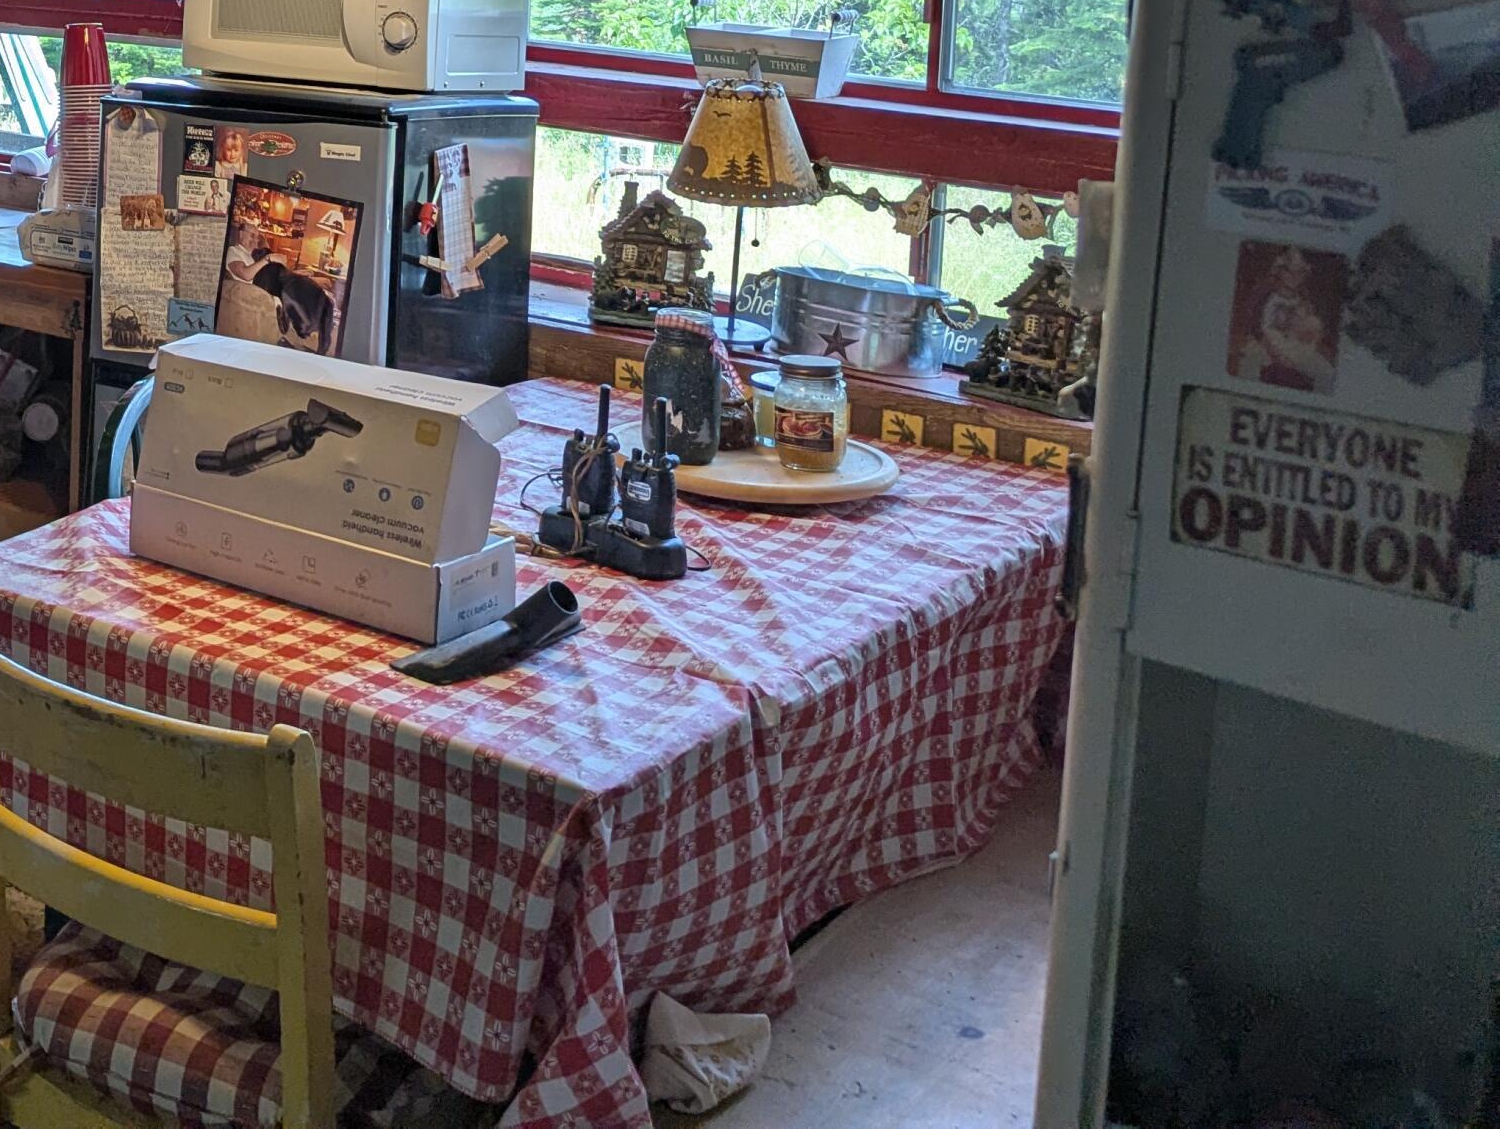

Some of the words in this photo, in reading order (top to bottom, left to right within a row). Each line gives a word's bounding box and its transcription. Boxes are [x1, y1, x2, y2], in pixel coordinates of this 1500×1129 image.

[704, 53, 739, 65] BASIL
[769, 59, 808, 73] THYME
[1229, 405, 1425, 480] EVERYONE
[1188, 444, 1214, 483] IS
[1222, 449, 1357, 512] ENTITLED
[1366, 476, 1404, 521] TO
[350, 509, 385, 524] cleaner
[387, 518, 425, 534] vacuum
[342, 520, 385, 539] handheld
[386, 531, 422, 549] Wireless
[1179, 485, 1462, 608] OPINION
